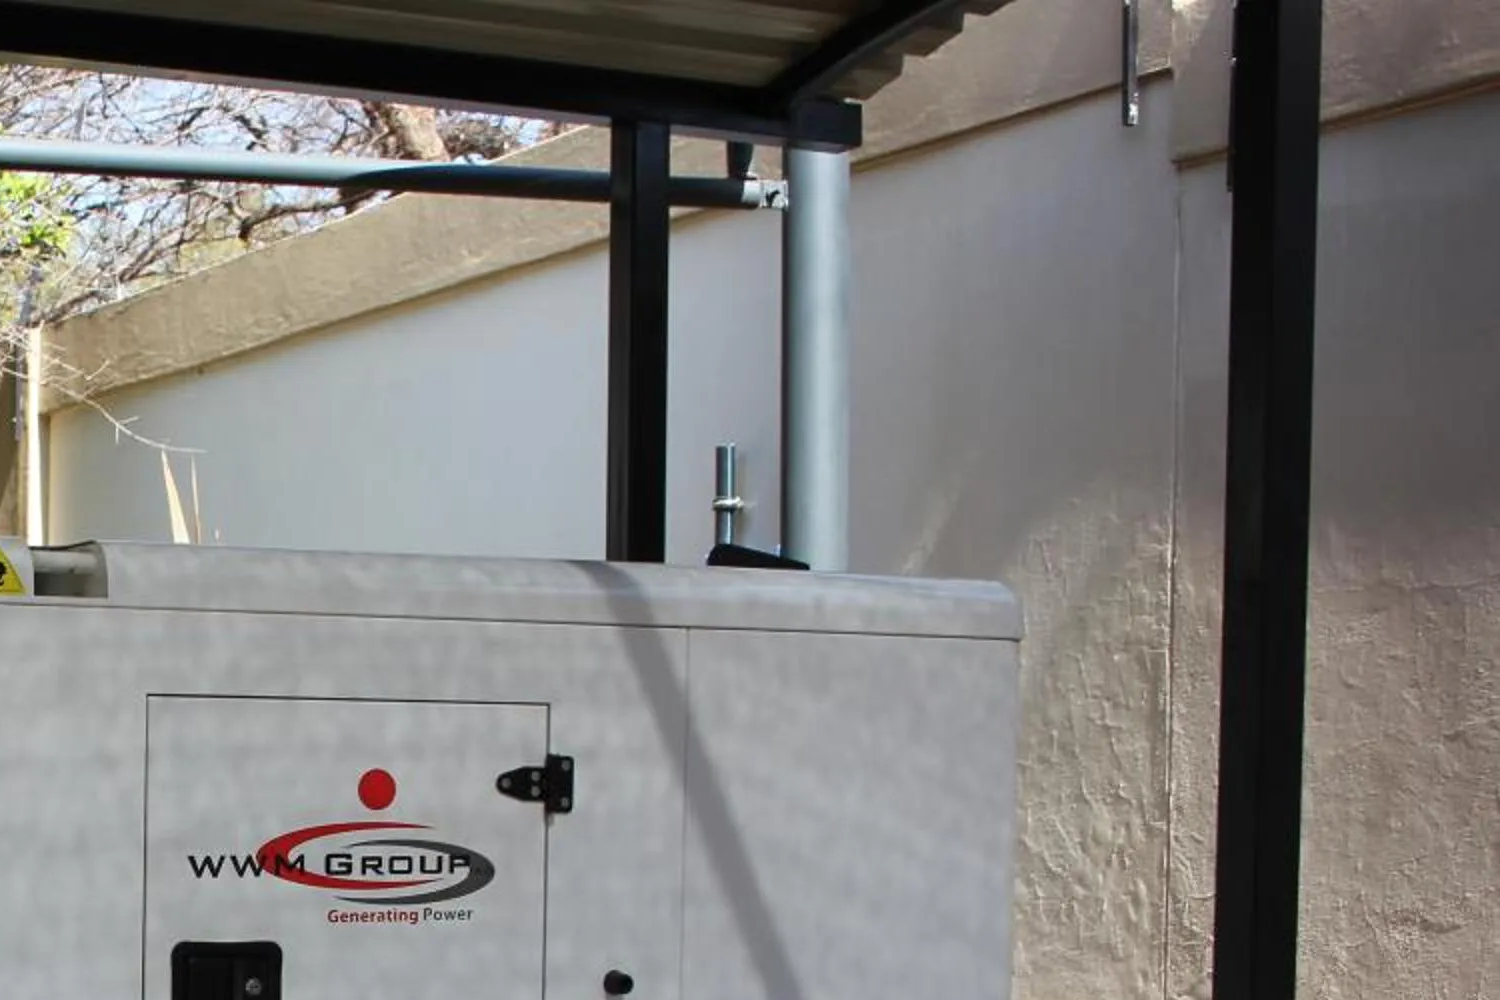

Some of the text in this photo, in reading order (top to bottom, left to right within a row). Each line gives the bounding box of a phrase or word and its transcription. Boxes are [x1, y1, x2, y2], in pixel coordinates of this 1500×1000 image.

[187, 852, 473, 879] WWM GROUP
[327, 906, 475, 925] Generating Power
